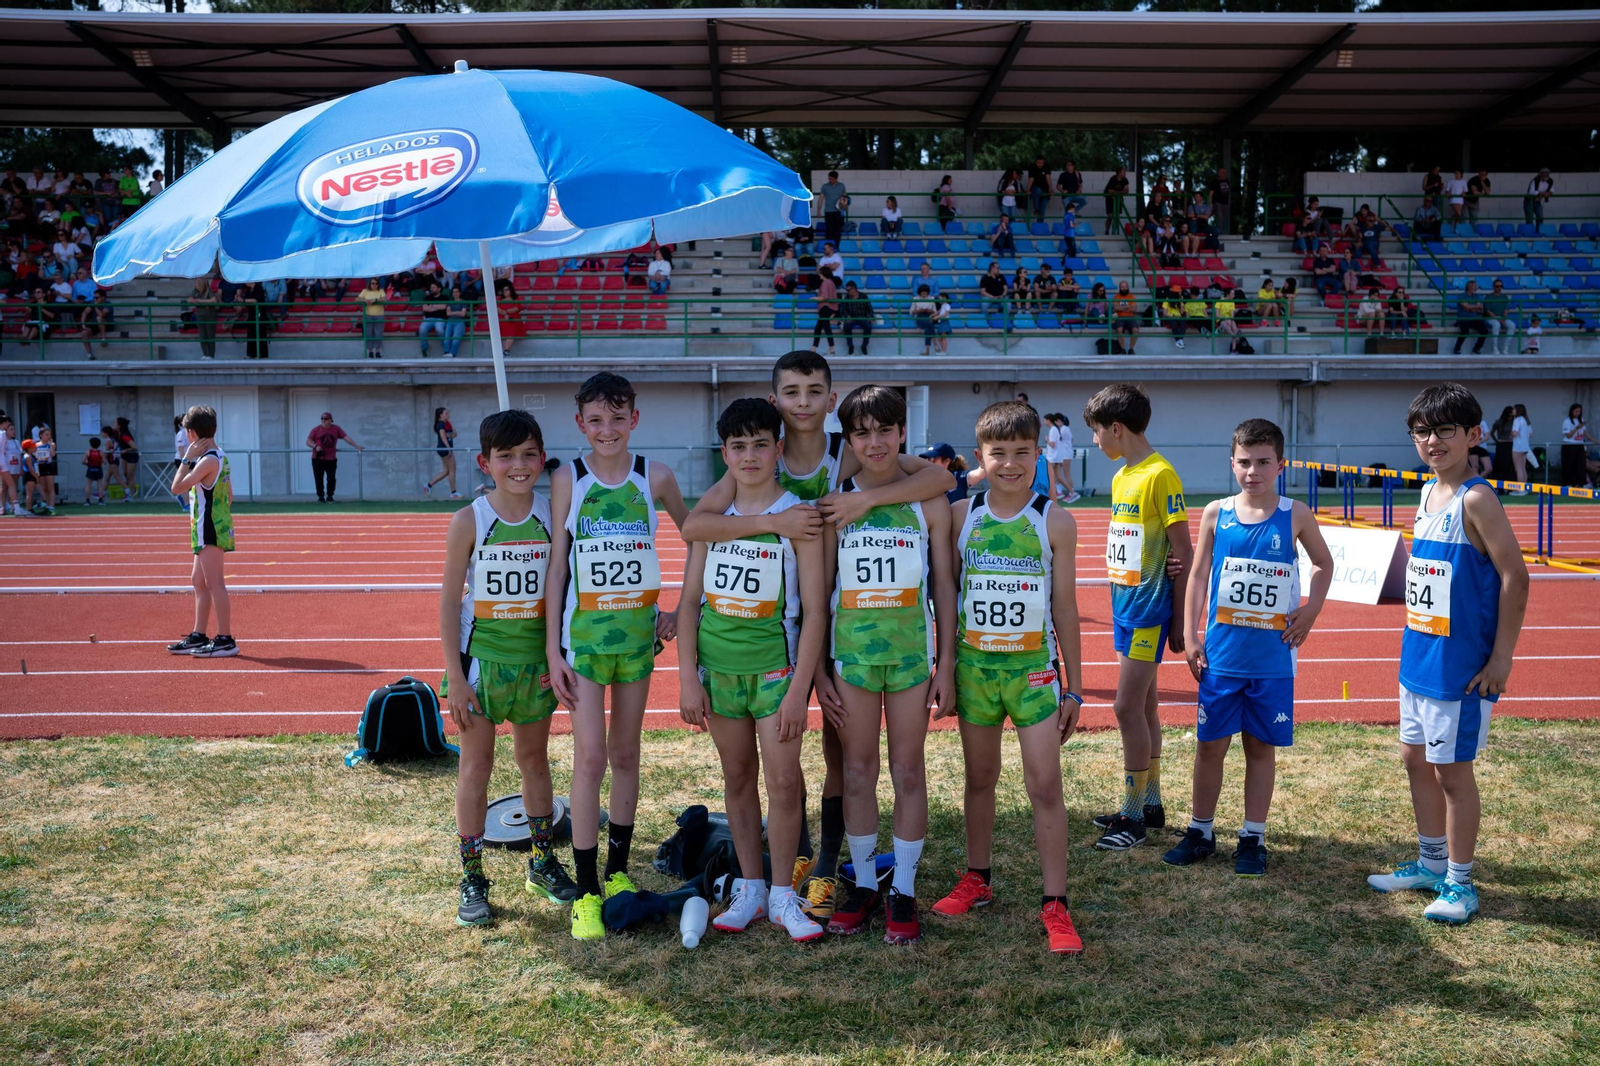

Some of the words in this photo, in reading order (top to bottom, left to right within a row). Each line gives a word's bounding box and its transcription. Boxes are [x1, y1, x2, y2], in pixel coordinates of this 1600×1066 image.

[335, 134, 442, 165] HELADOS
[321, 153, 456, 200] Nestlé
[581, 516, 648, 536] Natursueño
[579, 544, 599, 554] La
[710, 542, 727, 554] La
[841, 538, 859, 549] La
[478, 550, 498, 561] La
[967, 548, 1041, 570] Natursueño
[591, 560, 643, 587] 523
[856, 557, 896, 584] 511
[1224, 561, 1242, 572] La
[486, 570, 539, 595] 508
[714, 563, 760, 594] 576
[1308, 565, 1377, 586] LICIA
[968, 579, 983, 590] La
[1229, 581, 1278, 608] 365
[597, 600, 644, 611] telemiño
[715, 604, 758, 618] telemiño
[856, 599, 902, 609] telemiño
[492, 609, 539, 619] telemiño
[973, 600, 1026, 627] 583
[1232, 616, 1274, 630] telemiño
[979, 641, 1024, 651] telemiño
